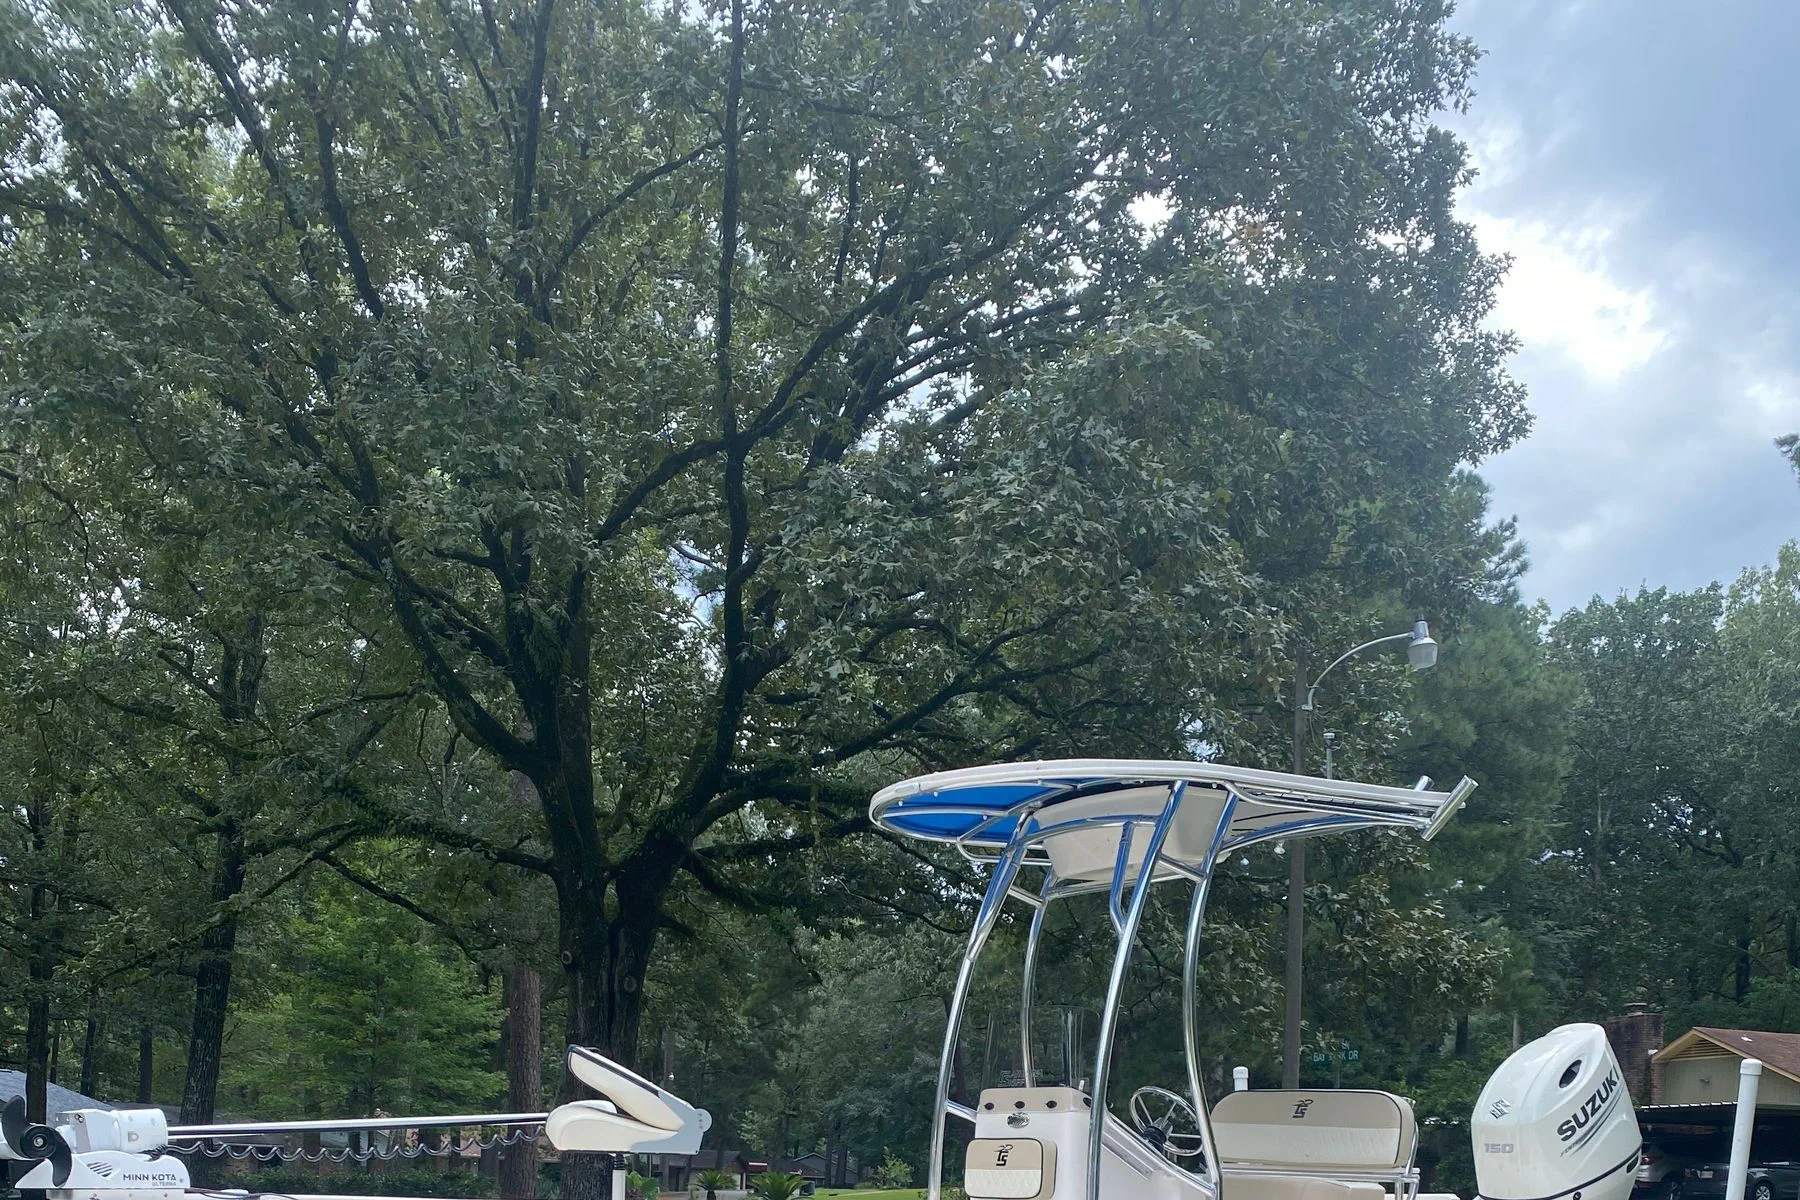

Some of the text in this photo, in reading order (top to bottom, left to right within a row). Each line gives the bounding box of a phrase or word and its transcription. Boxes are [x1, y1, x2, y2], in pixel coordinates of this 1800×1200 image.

[1556, 1064, 1620, 1142] SUZUKI
[1484, 1143, 1514, 1153] 150
[123, 1173, 176, 1181] MINN KOTA
